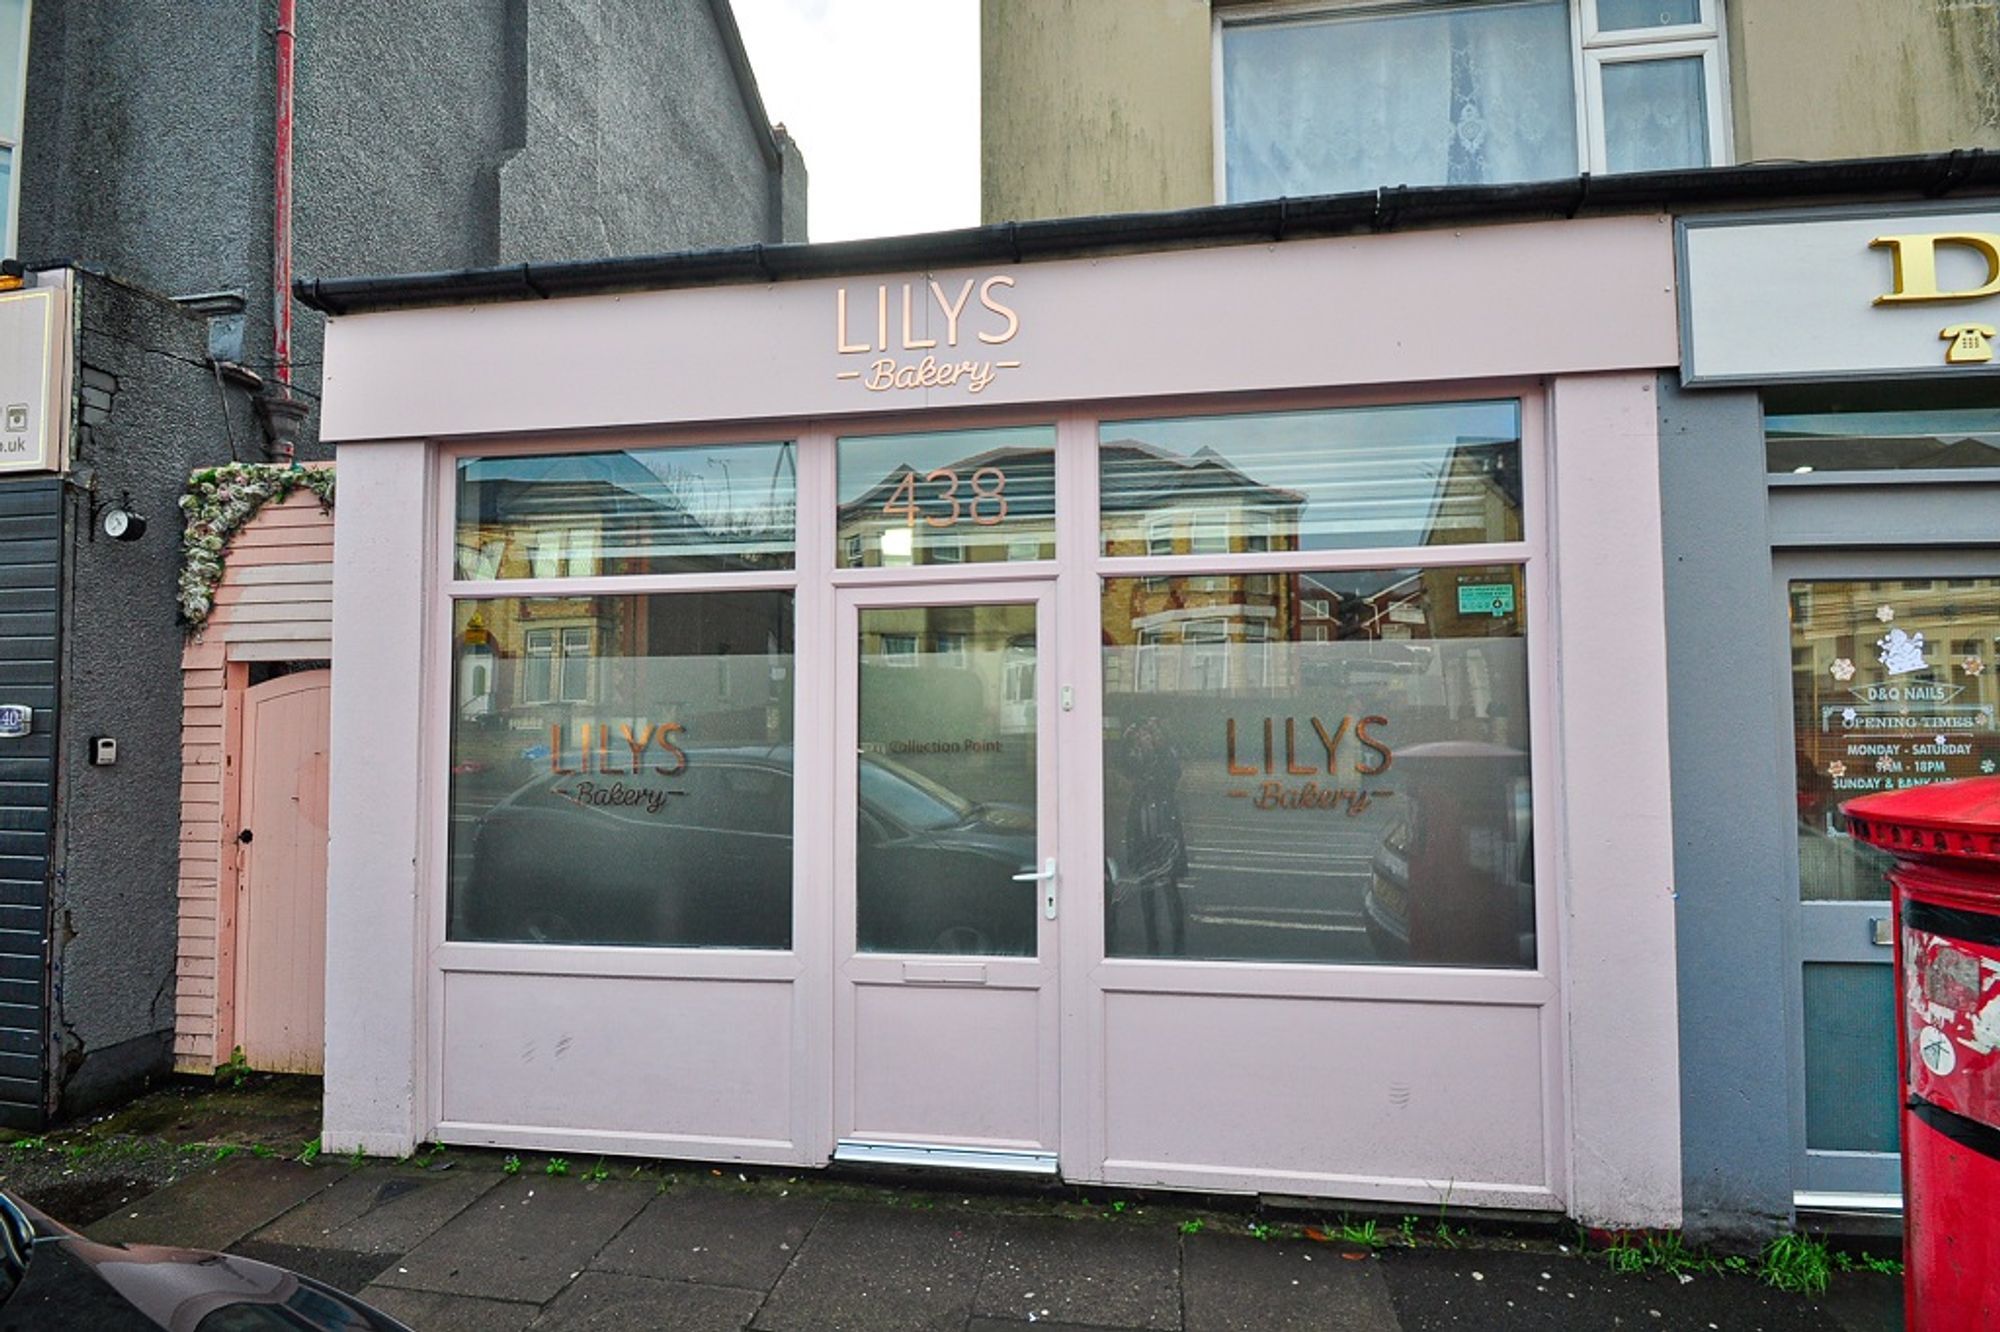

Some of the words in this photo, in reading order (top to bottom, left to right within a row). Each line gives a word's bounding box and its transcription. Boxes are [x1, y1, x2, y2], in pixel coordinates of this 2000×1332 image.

[837, 275, 1020, 354] LILYS
[865, 355, 996, 393] Bakery
[882, 466, 1009, 528] 438
[1903, 687, 1945, 700] NAILS
[1842, 716, 1918, 729] OPENING
[1920, 716, 1975, 728] TIMES
[551, 722, 687, 776] LILYS
[964, 738, 1003, 753] Point
[1227, 715, 1393, 776] LILYS
[1847, 744, 1900, 756] MONDAY
[1911, 743, 1972, 755] SATURDAY
[1914, 760, 1946, 773] 18PM
[576, 781, 667, 813] Bakery
[1254, 781, 1372, 817] Bakery
[1832, 778, 1881, 789] SUNDAY
[1884, 777, 1894, 789] &
